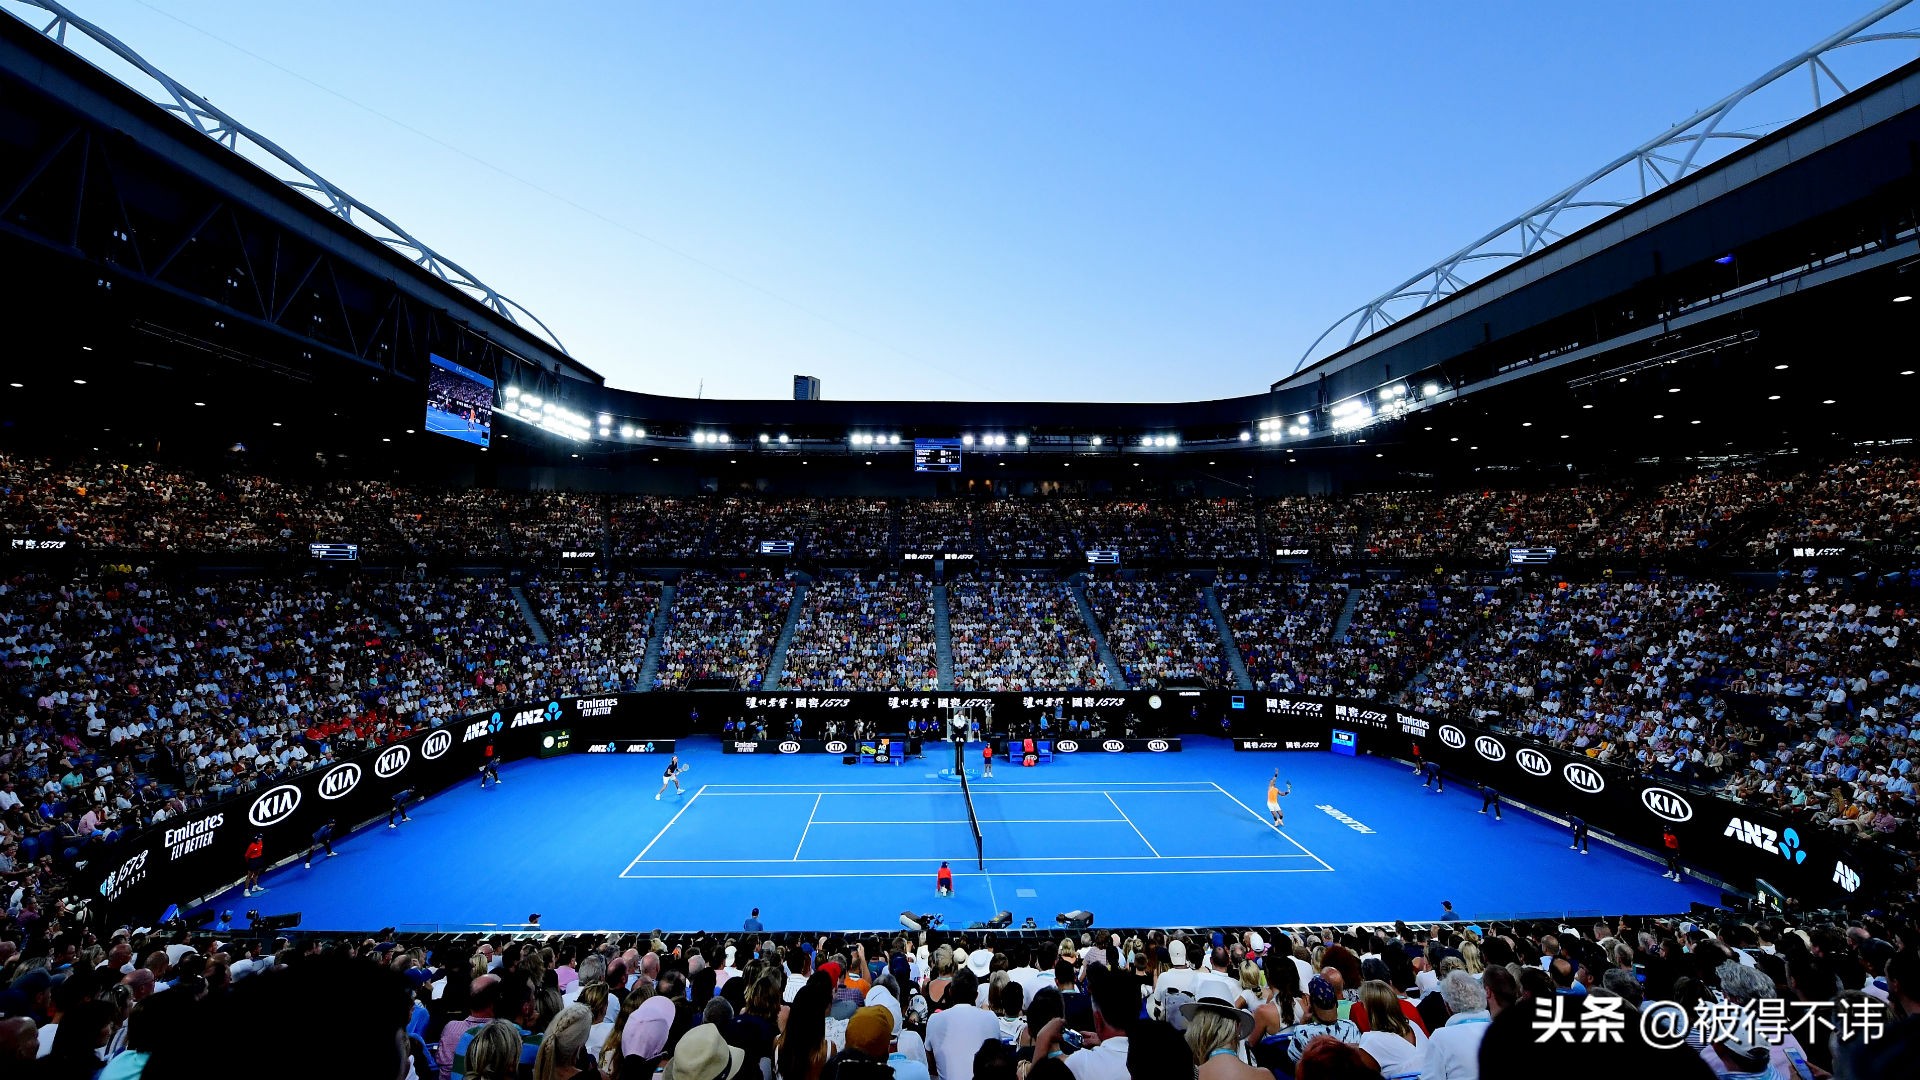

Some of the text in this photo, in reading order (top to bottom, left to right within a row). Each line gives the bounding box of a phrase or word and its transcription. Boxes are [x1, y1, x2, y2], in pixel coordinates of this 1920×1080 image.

[576, 698, 618, 709] Emirates
[510, 708, 544, 728] ANZ
[1396, 712, 1430, 730] Emirates
[463, 720, 489, 743] ANZ
[1443, 729, 1460, 744] KIA
[427, 735, 447, 755] KIA
[1479, 740, 1499, 758] KIA
[380, 750, 405, 773] KIA
[1521, 754, 1545, 773] KIA
[326, 769, 355, 795] KIA
[1569, 768, 1597, 789] KIA
[258, 792, 293, 821] KIA
[1650, 794, 1685, 818] KIA
[165, 813, 224, 848] Emirates
[1723, 817, 1779, 855] ANZ
[171, 831, 214, 860] FLY BETTER
